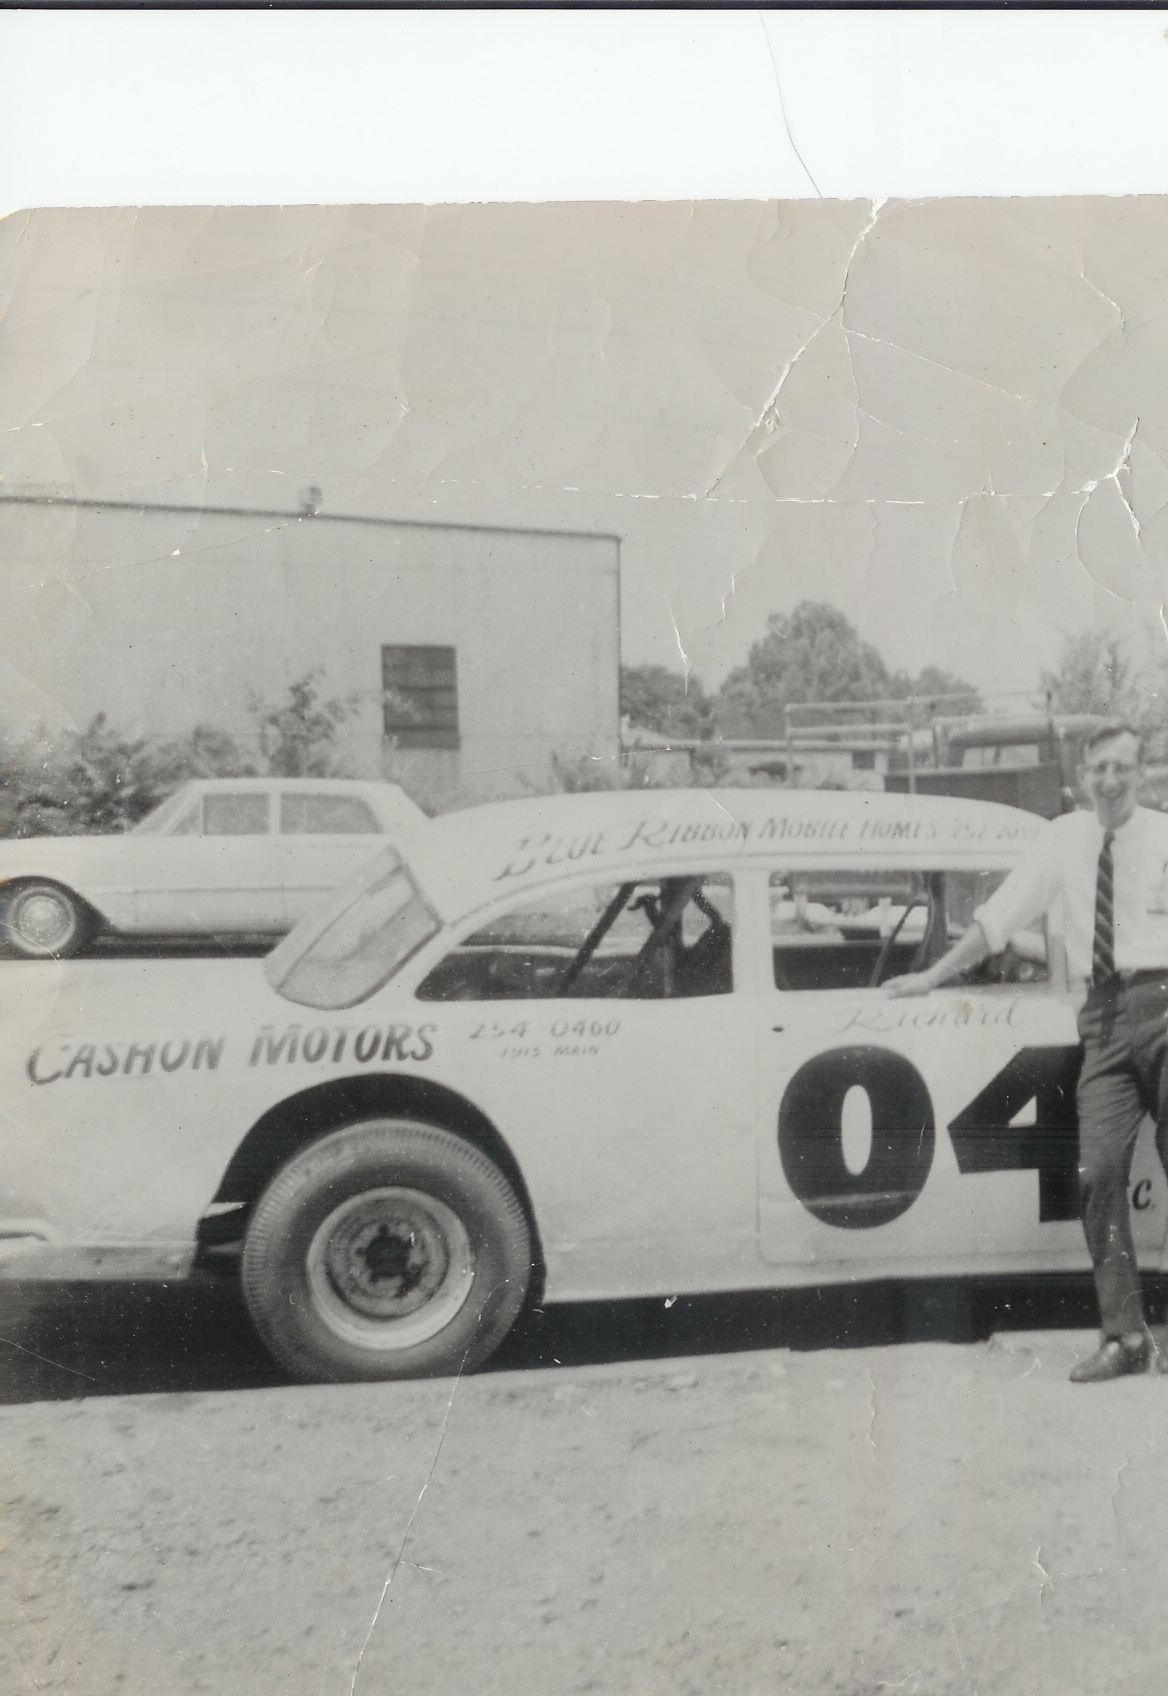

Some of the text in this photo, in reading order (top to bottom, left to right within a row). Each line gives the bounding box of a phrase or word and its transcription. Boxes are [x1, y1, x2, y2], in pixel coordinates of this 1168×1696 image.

[492, 831, 609, 881] BLUE
[617, 819, 752, 850] RIBBON
[757, 816, 849, 839] MOBILE
[858, 818, 938, 840] HOMES
[25, 1023, 438, 1086] CASHON MOTORS
[553, 1044, 600, 1057] MAIN
[777, 1044, 1084, 1229] 04
